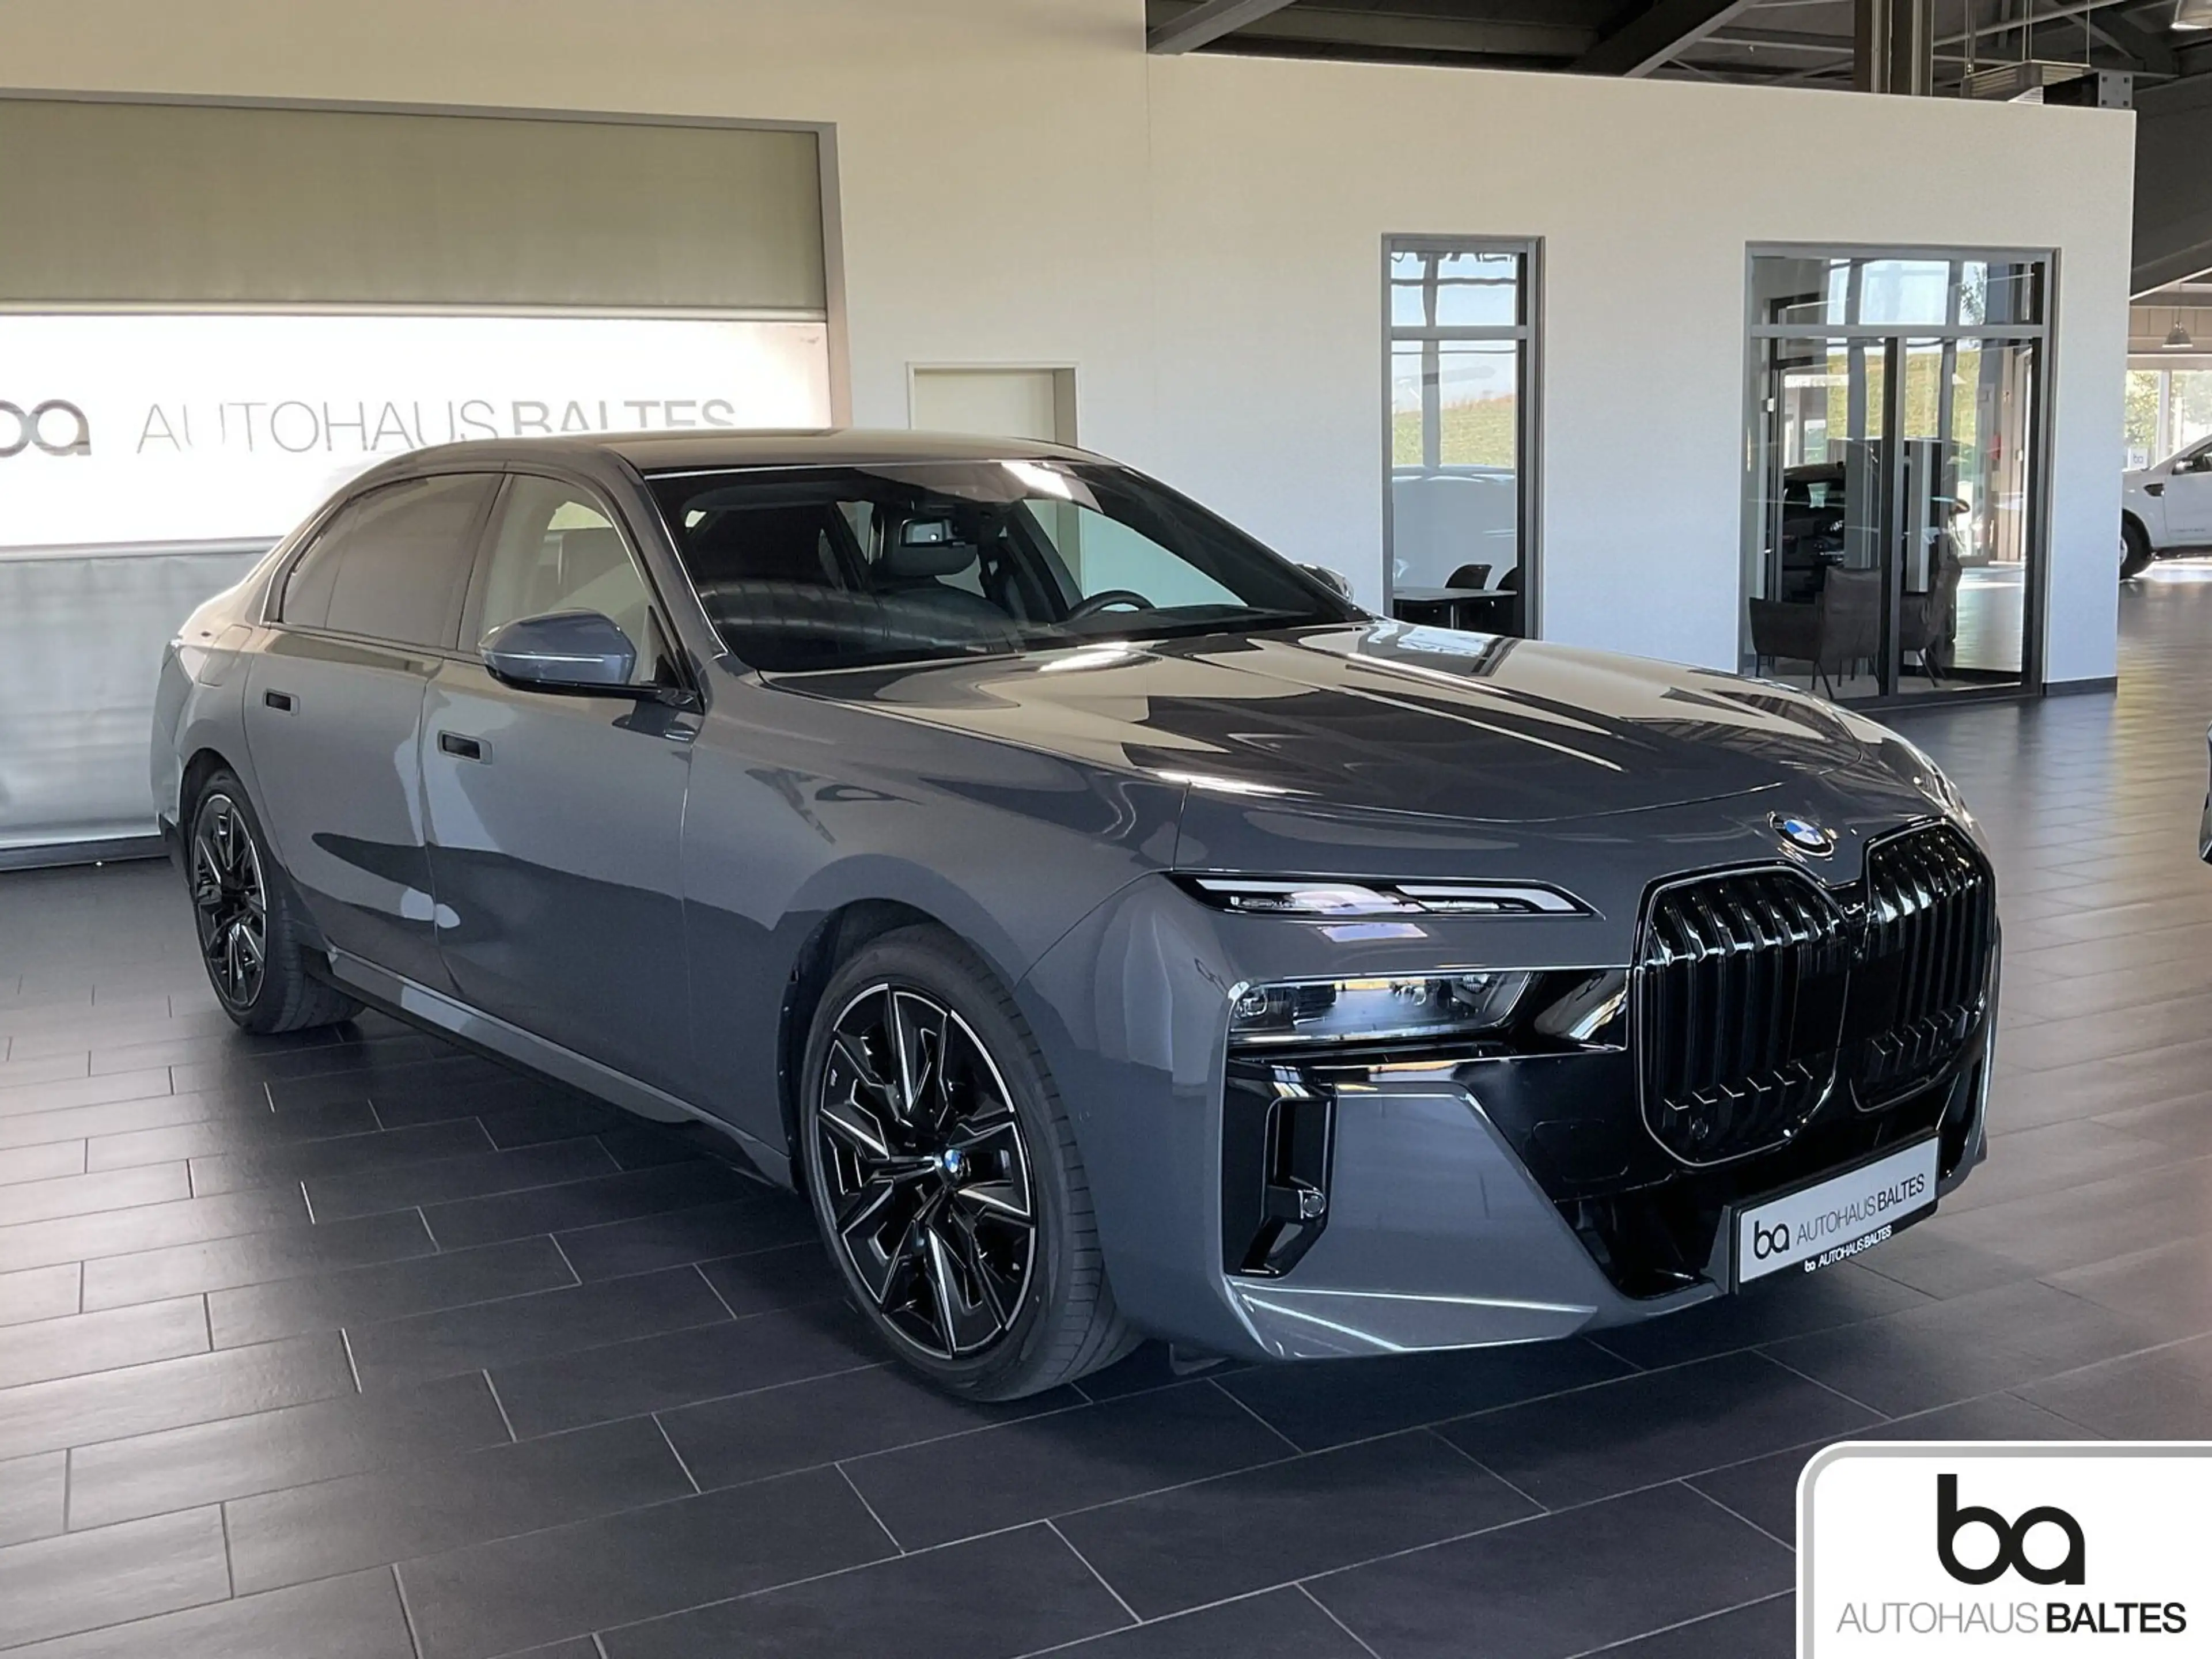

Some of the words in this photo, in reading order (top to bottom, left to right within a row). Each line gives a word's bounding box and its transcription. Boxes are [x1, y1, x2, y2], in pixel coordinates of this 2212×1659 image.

[136, 400, 499, 454] AUTOHAUS
[1754, 1220, 1790, 1260] ba
[1796, 1195, 1877, 1245] AUTOHAUS
[1877, 1173, 1925, 1213] BALTES
[1863, 1224, 1892, 1248] BALTES
